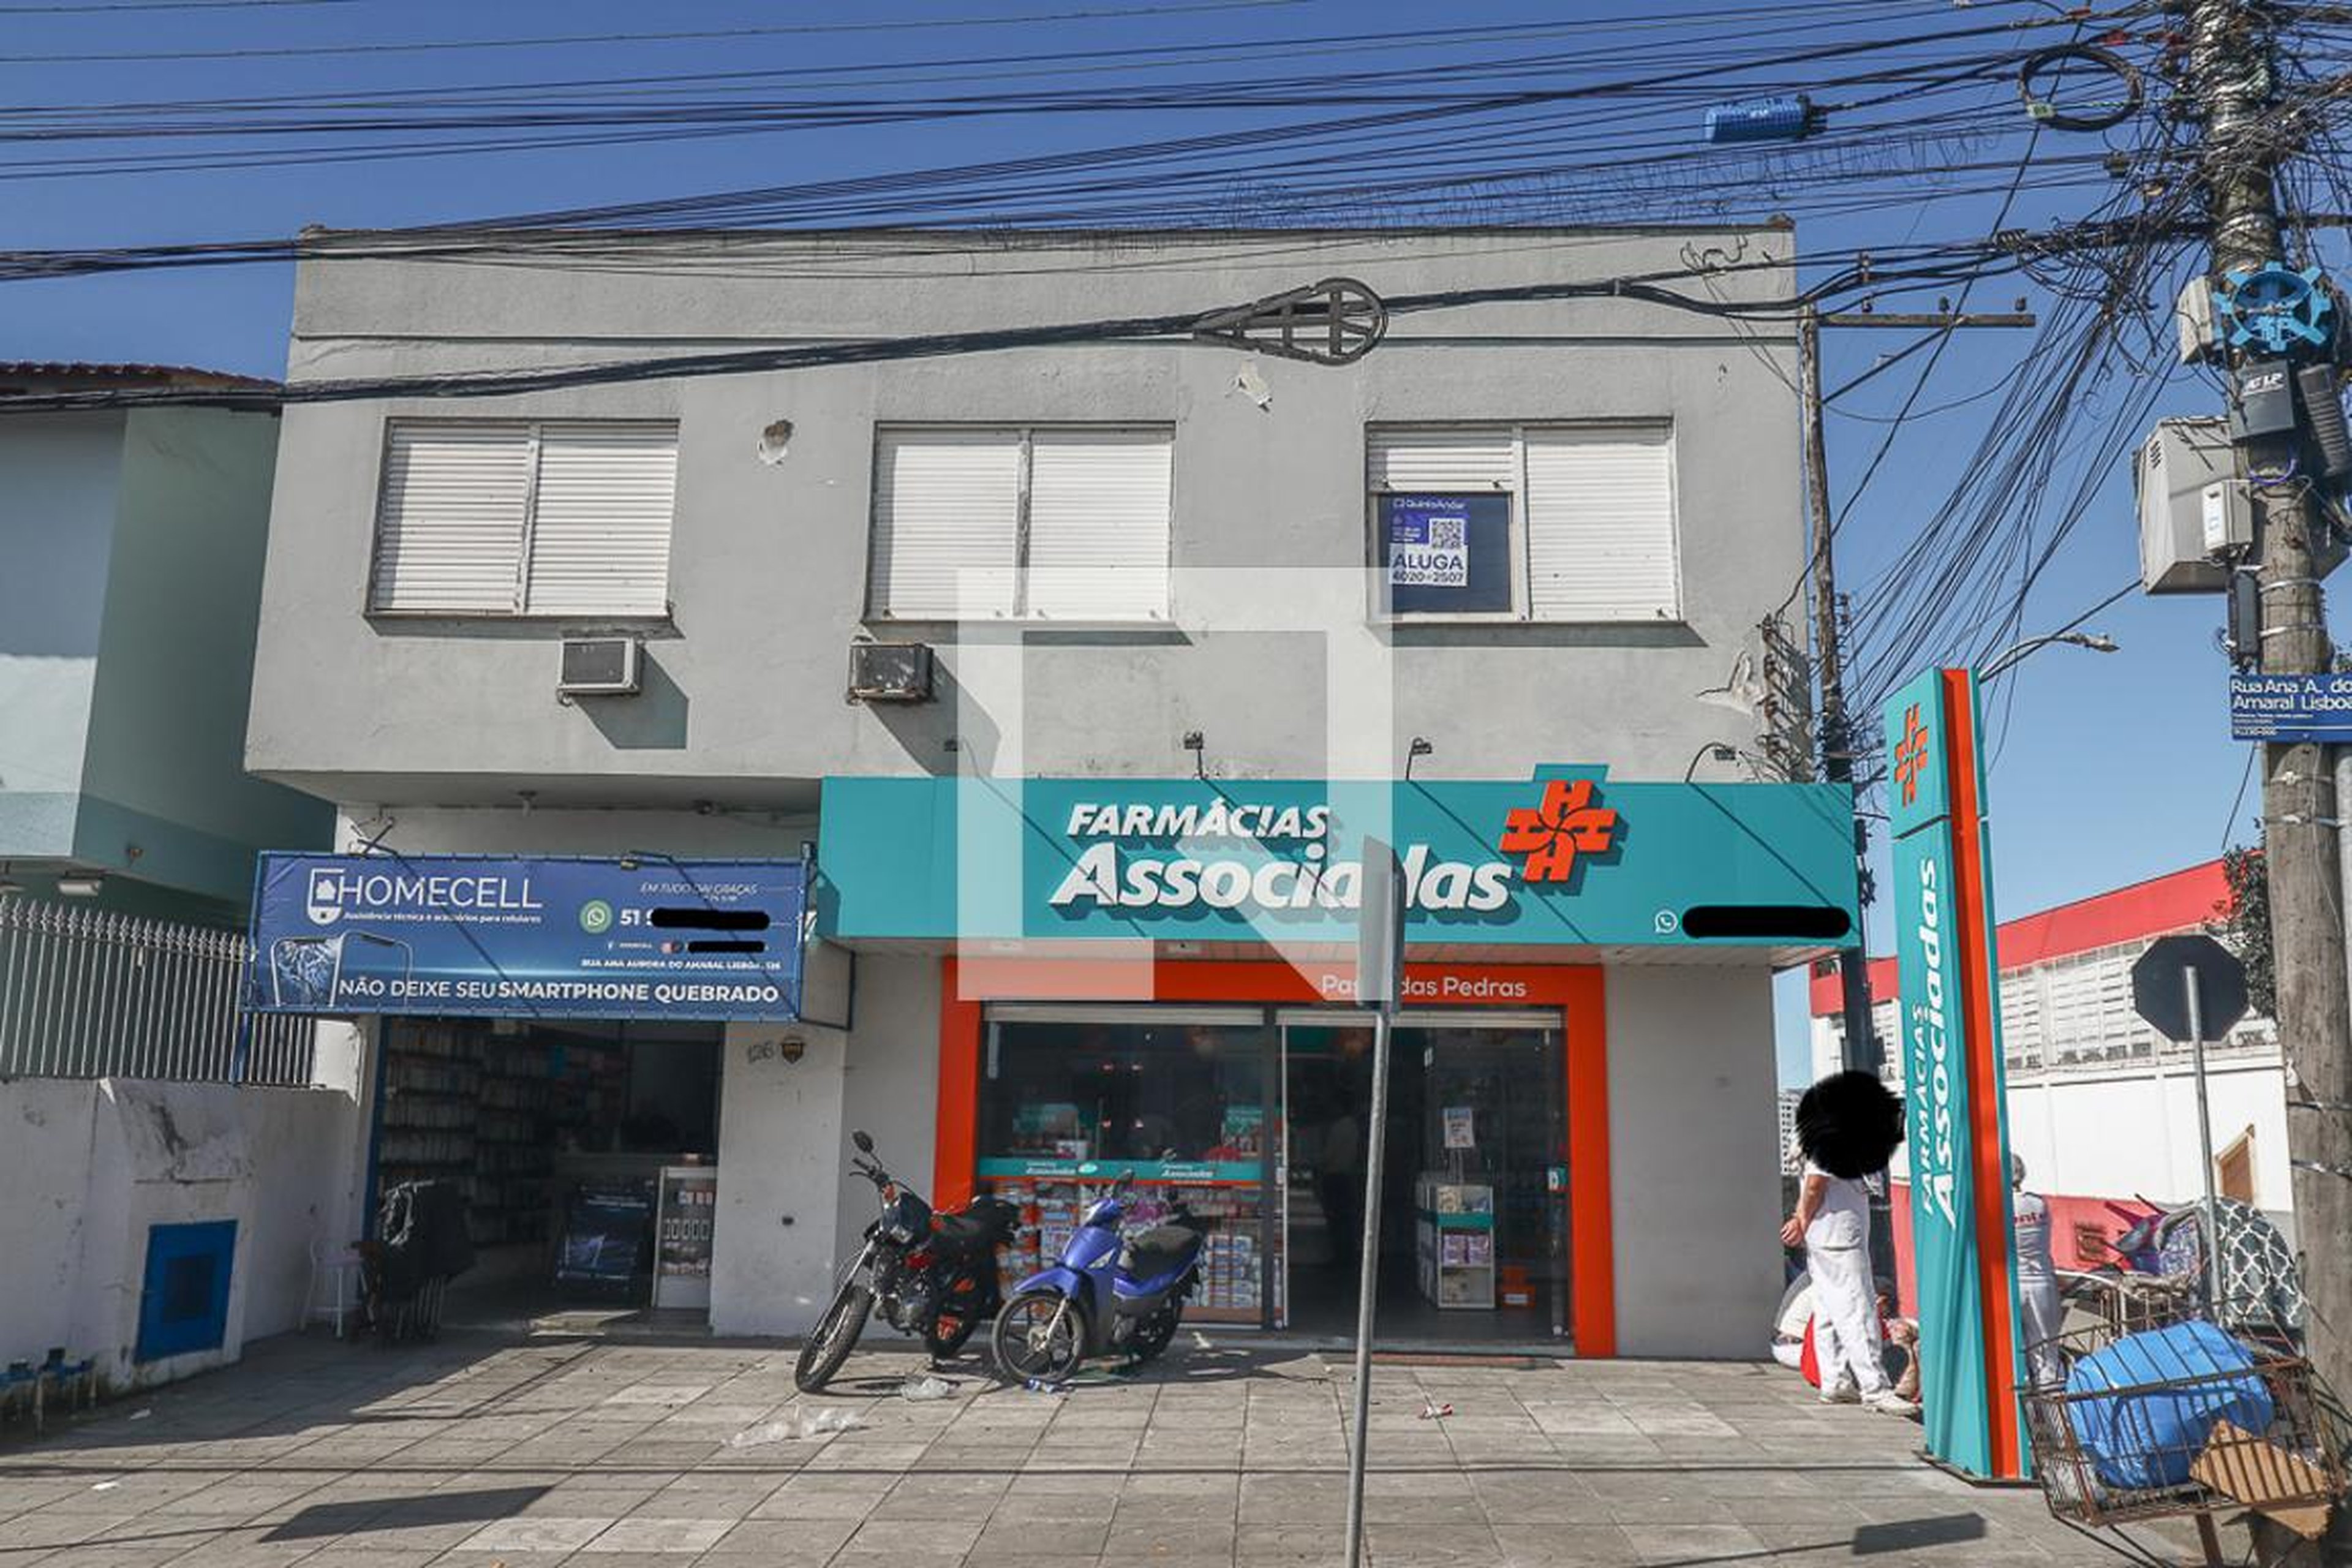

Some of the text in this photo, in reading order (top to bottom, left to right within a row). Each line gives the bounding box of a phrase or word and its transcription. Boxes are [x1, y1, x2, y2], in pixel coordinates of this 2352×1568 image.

[1392, 554, 1464, 570] ALUGA
[2231, 679, 2263, 693] Rua
[2264, 679, 2298, 693] Ana
[2304, 679, 2324, 693] A.
[2233, 695, 2294, 710] Amaral
[1066, 796, 1330, 838] FARMÁCIAS
[337, 875, 543, 908] HOMECELL
[620, 909, 640, 926] 51
[338, 976, 779, 1004] NÃO DEIXE SEU SMARTPHONE QUEBRADO
[1442, 976, 1527, 997] Pedras
[1919, 858, 1956, 1231] Associadas
